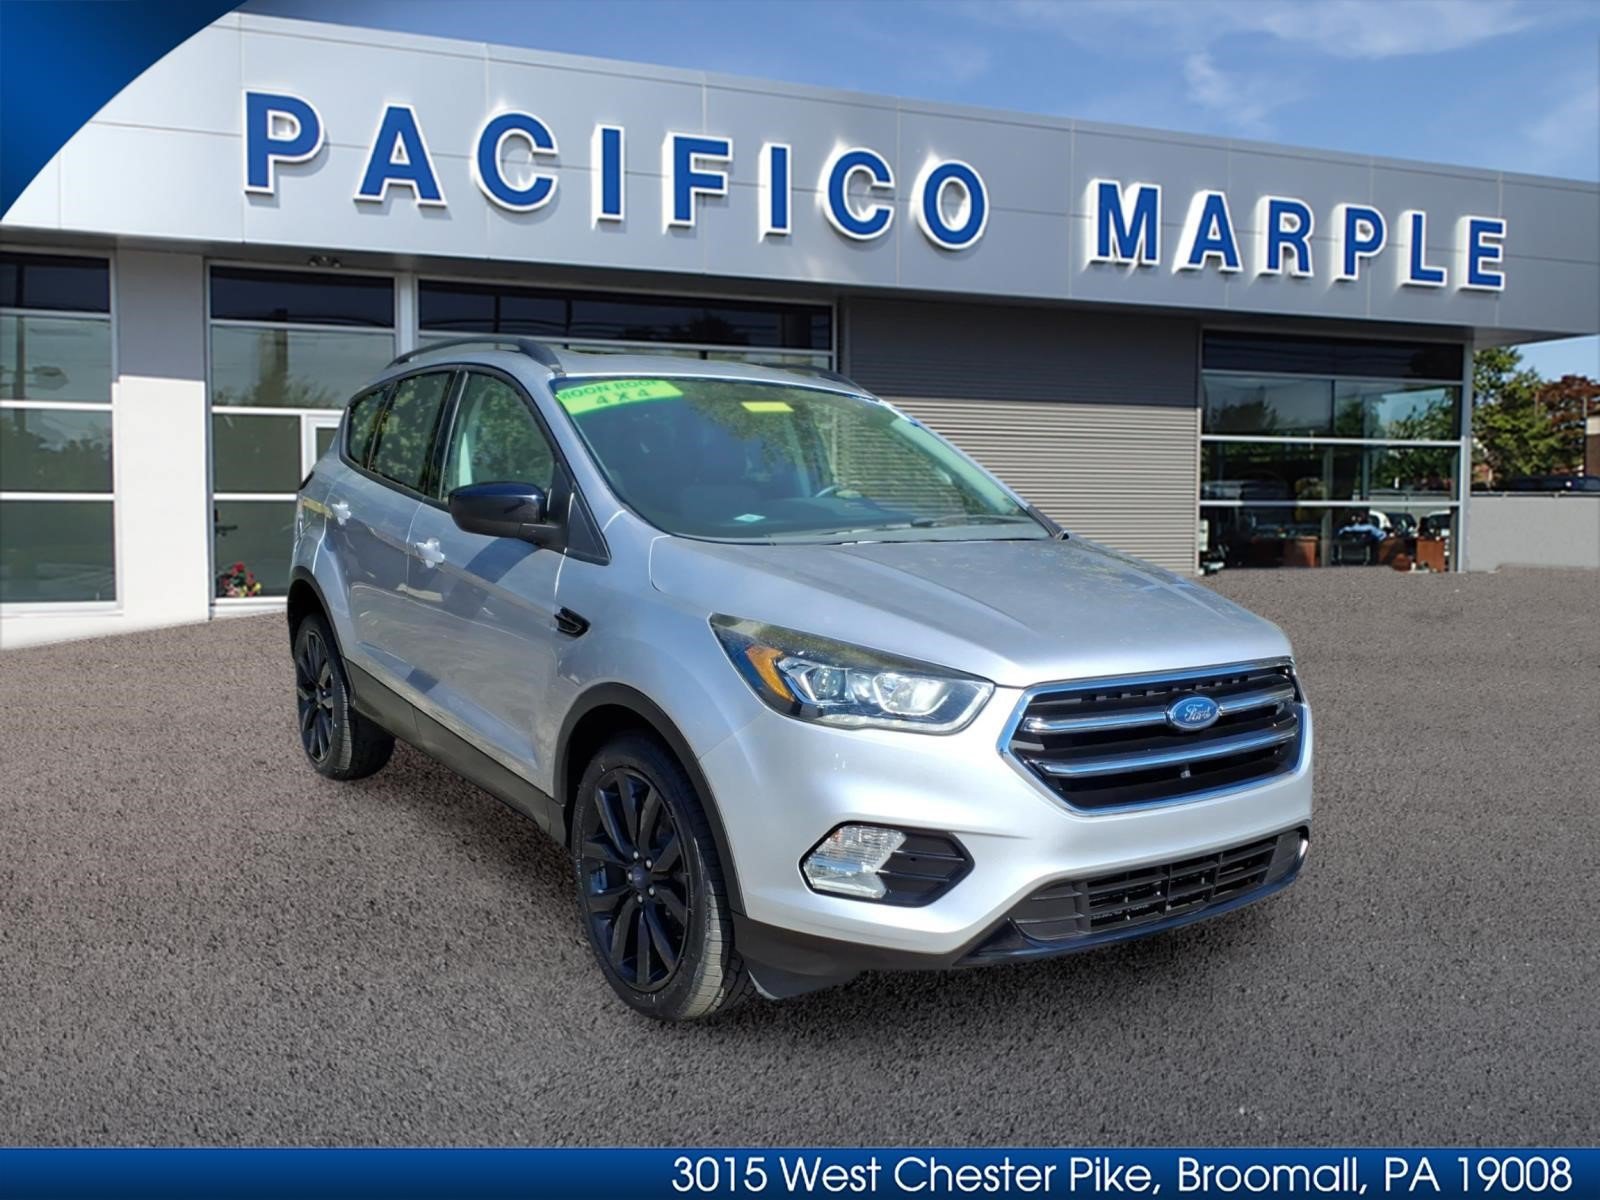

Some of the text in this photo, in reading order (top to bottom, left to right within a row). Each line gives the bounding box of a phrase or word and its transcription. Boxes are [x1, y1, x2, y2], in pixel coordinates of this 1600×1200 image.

[242, 89, 1507, 293] PACIFICO MARPLE
[1184, 703, 1212, 722] Ford
